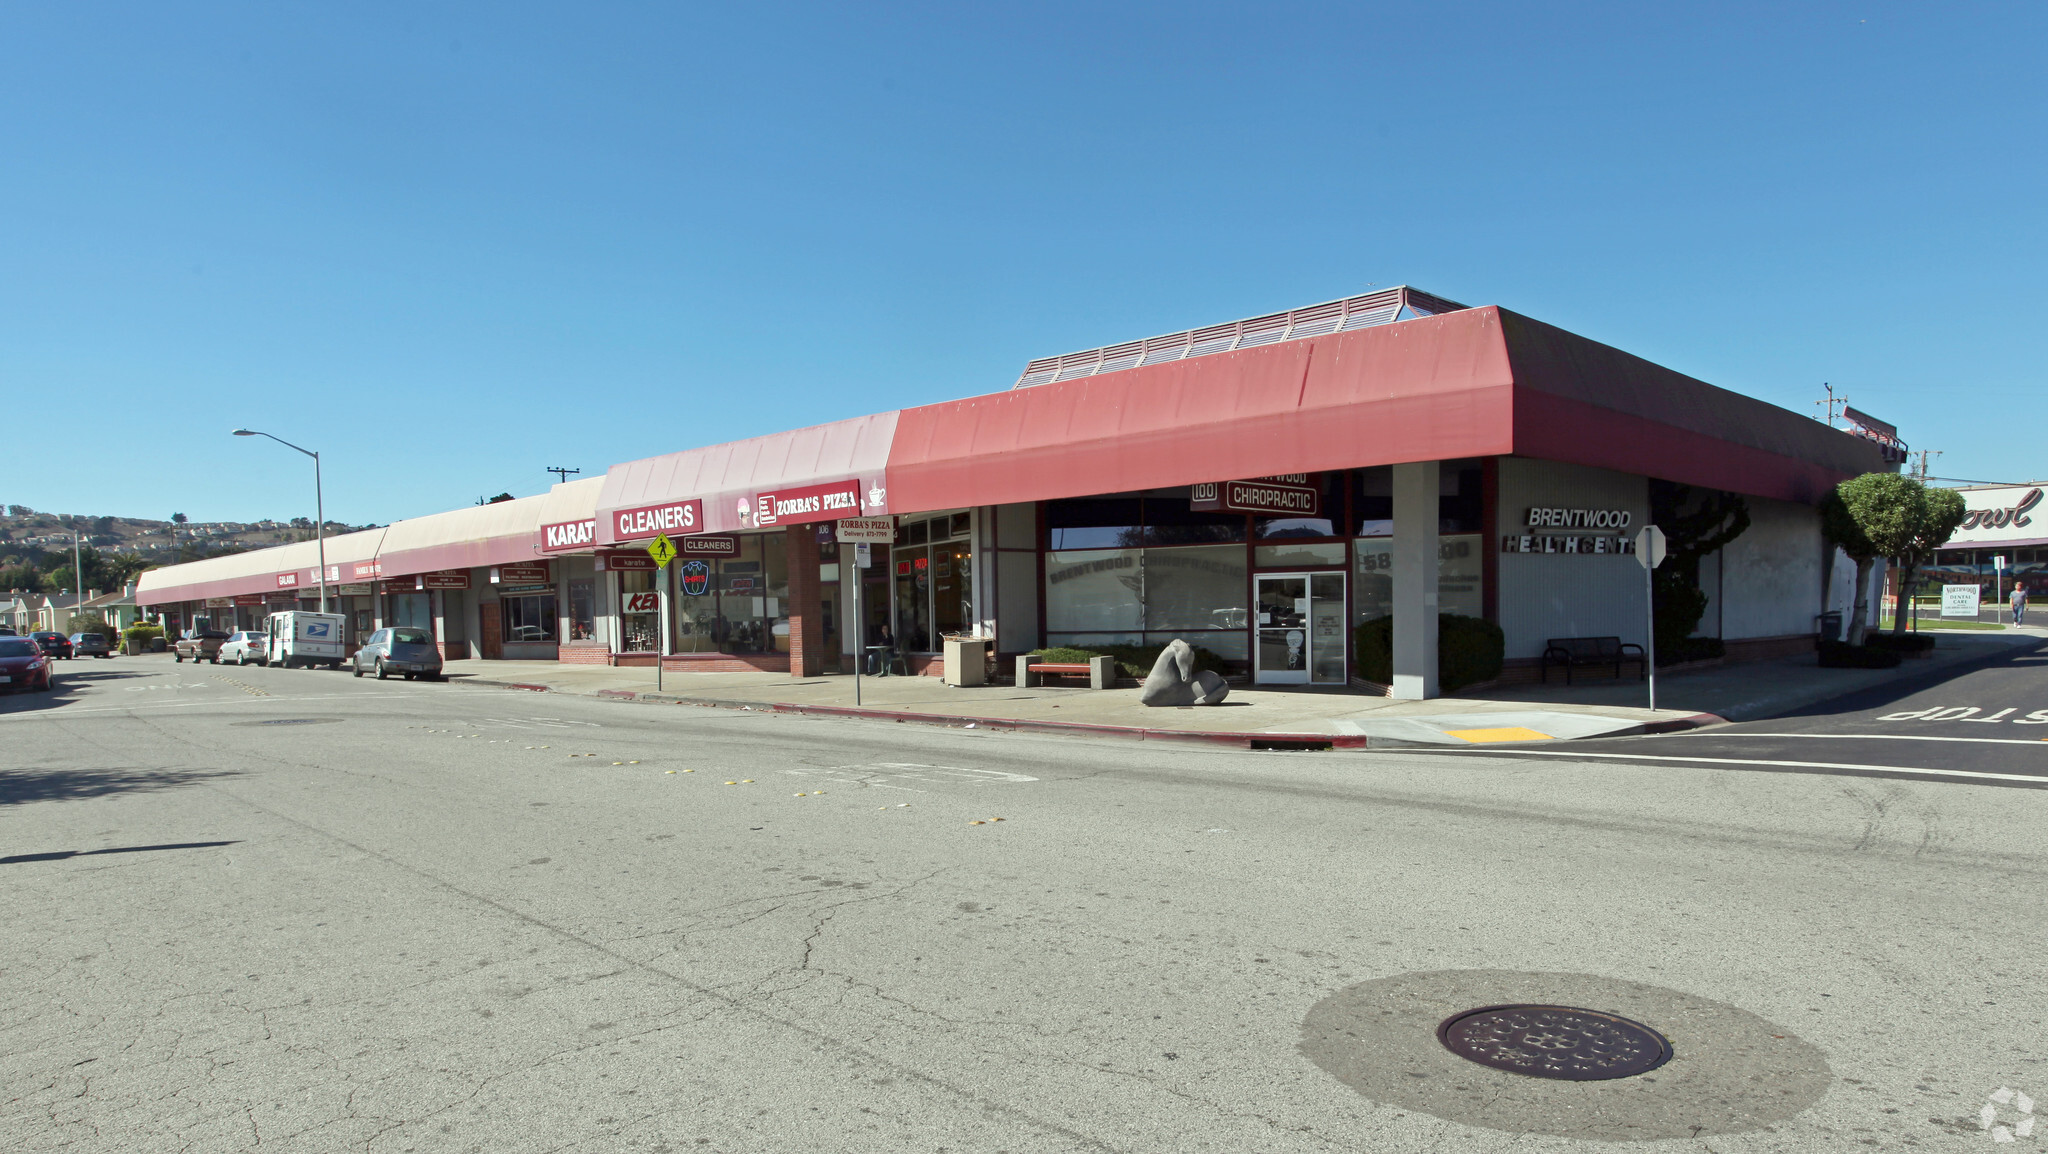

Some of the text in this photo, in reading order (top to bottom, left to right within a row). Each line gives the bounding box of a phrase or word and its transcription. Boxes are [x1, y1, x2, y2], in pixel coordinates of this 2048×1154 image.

[776, 496, 820, 516] ZORBA'S
[823, 491, 856, 510] PIZZA
[1233, 487, 1311, 509] CHIROPRACTIC
[619, 504, 694, 535] CLEANERS
[840, 520, 891, 530] ZORBA'S PIZZA
[1528, 507, 1631, 528] BRENTWOOD
[547, 520, 598, 547] KARAT
[844, 530, 865, 538] Delivery
[686, 540, 732, 551] CLEANERS
[1502, 536, 1578, 554] HEALTH
[623, 558, 646, 567] karate
[1050, 557, 1133, 585] BRENTWOOD
[684, 575, 706, 584] SHIRTS
